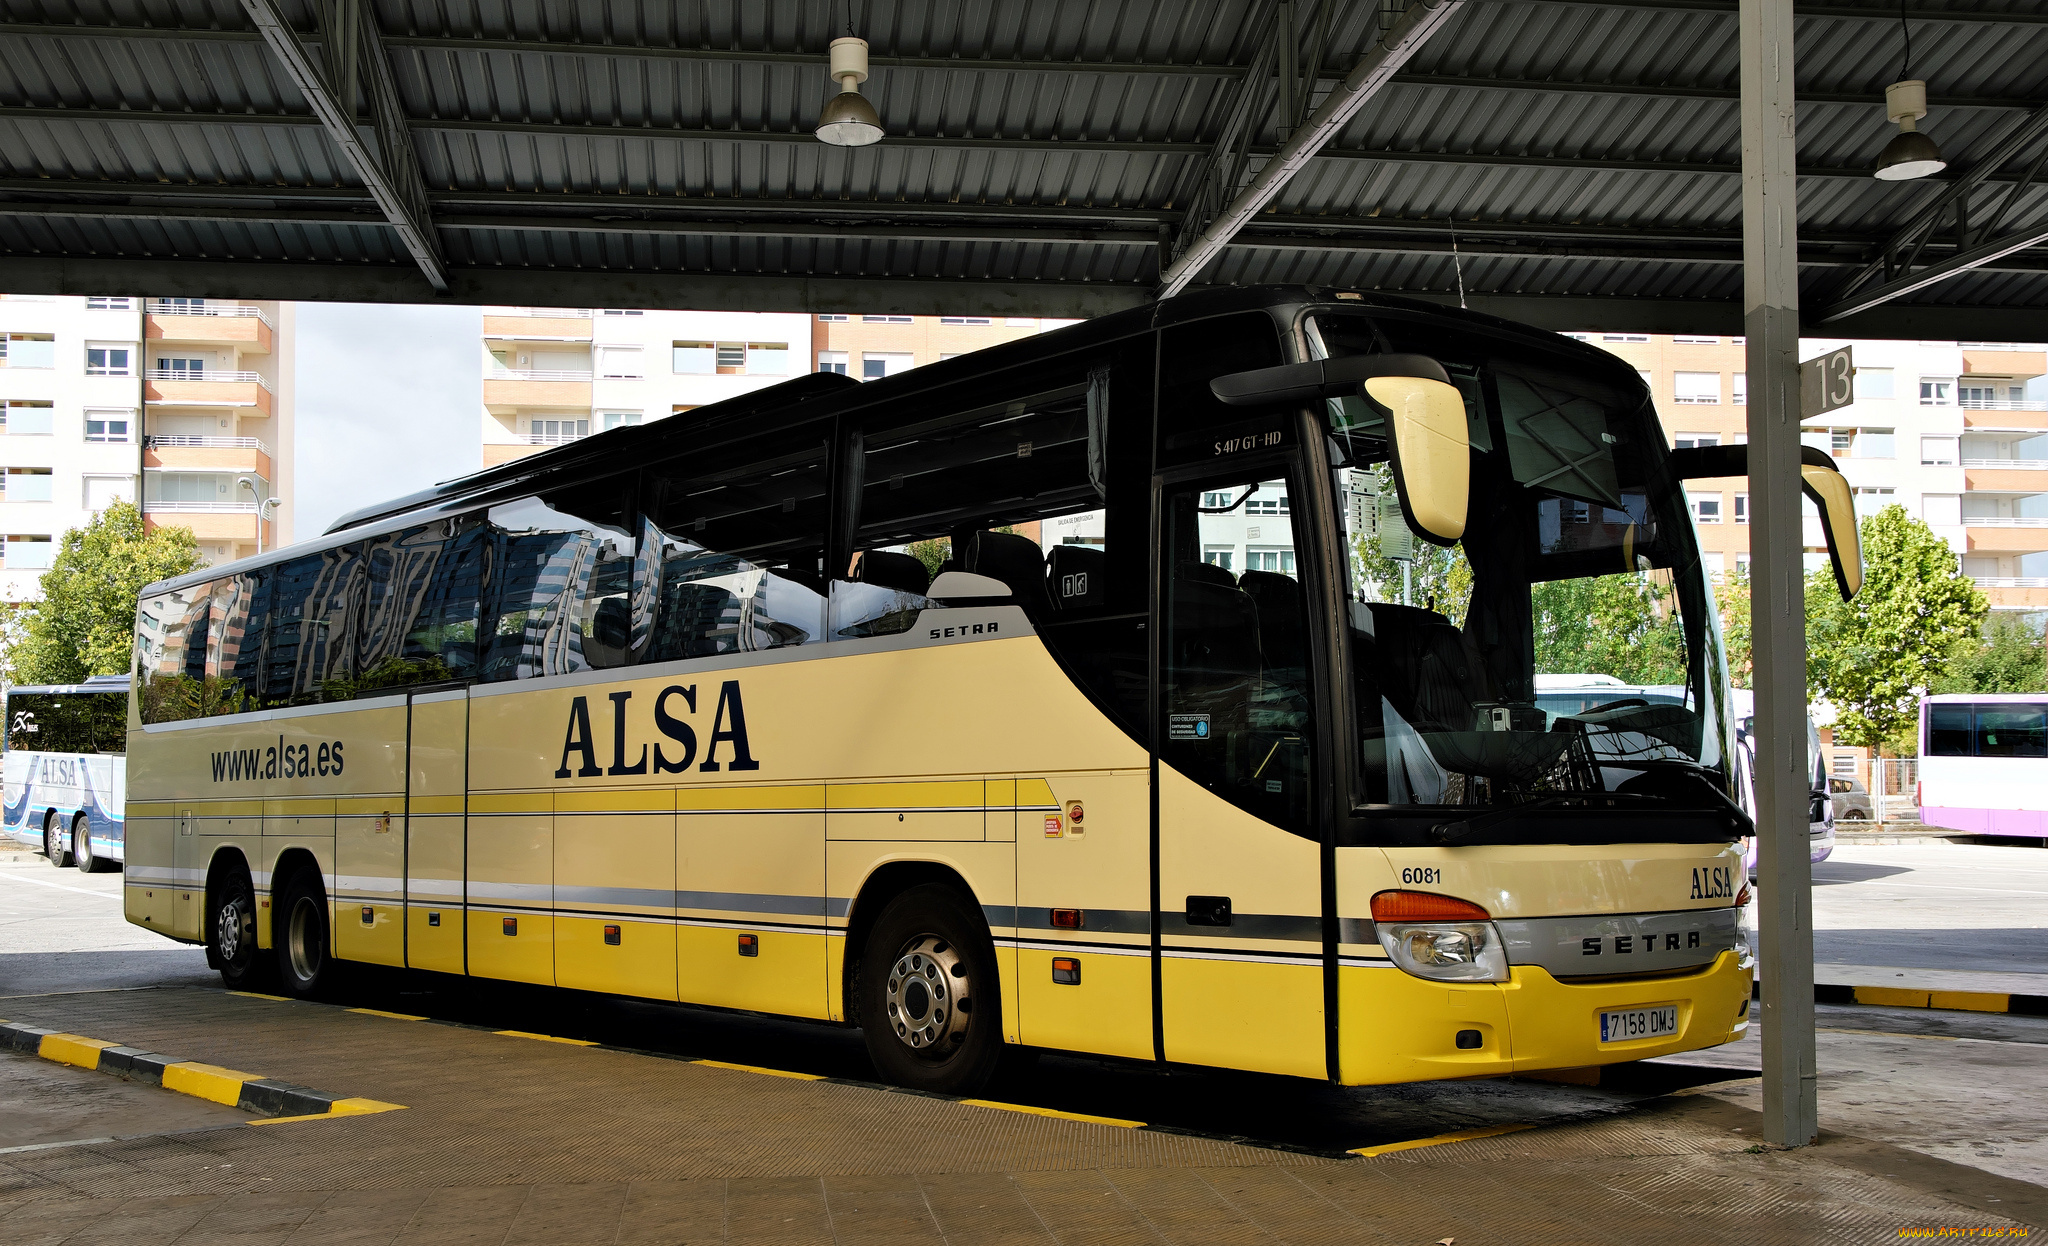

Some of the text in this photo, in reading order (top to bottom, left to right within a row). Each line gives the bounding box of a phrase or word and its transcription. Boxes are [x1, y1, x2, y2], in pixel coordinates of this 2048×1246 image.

[1815, 351, 1851, 409] 13
[1214, 441, 1222, 456] S
[1223, 438, 1240, 454] 417
[929, 622, 999, 640] SETRA
[554, 679, 760, 779] ALSA
[40, 758, 78, 787] ALSA
[211, 734, 344, 782] www.alsa.es
[1402, 867, 1441, 885] 6081
[1690, 866, 1734, 900] ALSA
[1582, 931, 1701, 956] SETRA
[1611, 1009, 1675, 1038] 7158 DMJ
